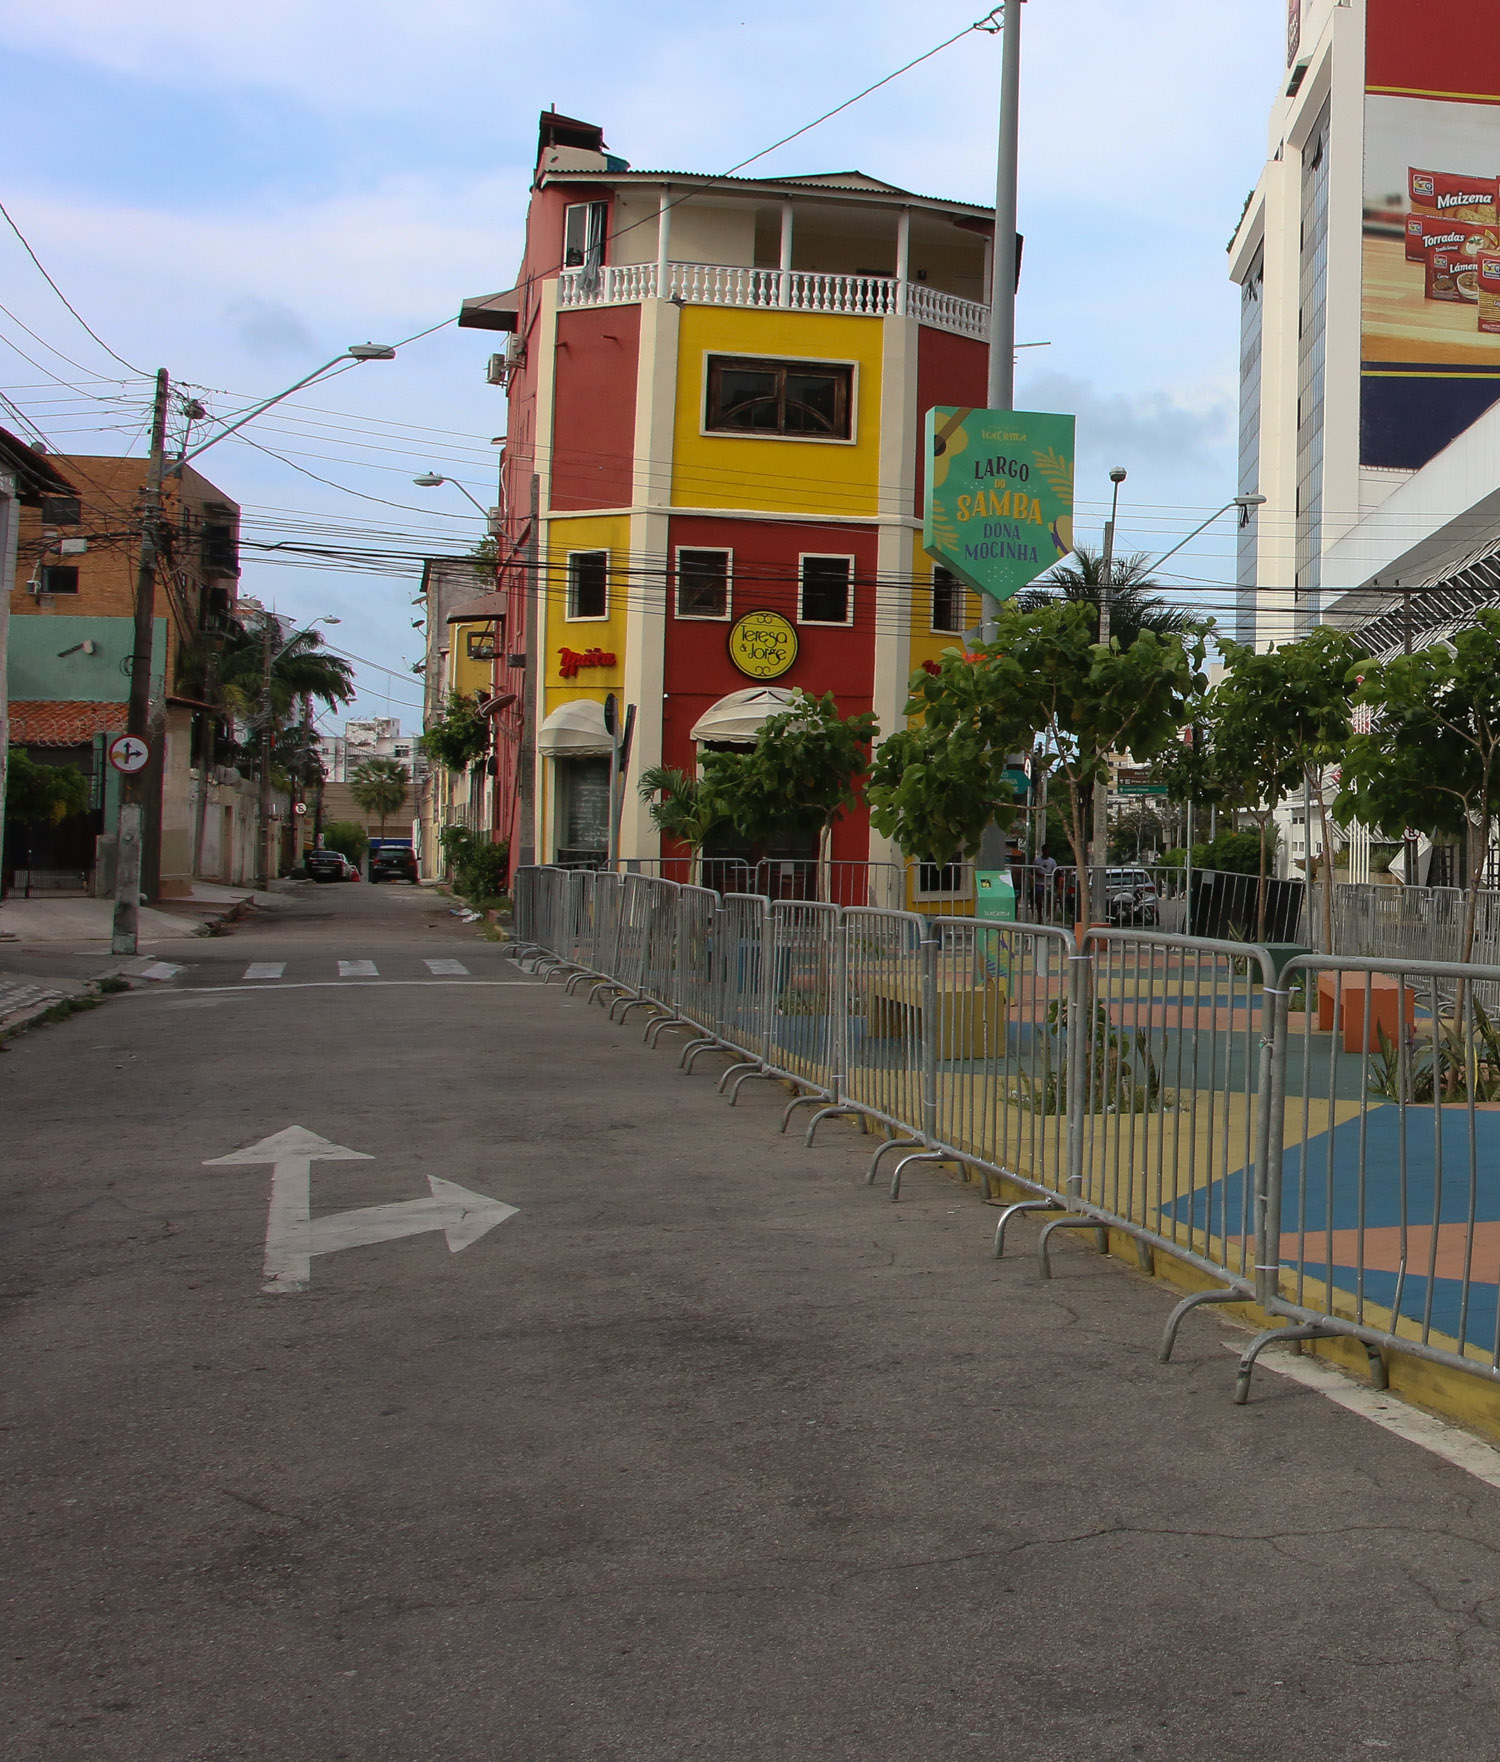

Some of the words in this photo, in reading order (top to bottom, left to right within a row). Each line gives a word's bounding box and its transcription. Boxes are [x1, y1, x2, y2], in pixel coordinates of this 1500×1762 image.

[1437, 192, 1492, 209] Maizena
[1422, 232, 1465, 247] Torradas
[974, 456, 1030, 482] LARGO
[994, 478, 1006, 489] DO
[956, 489, 1043, 526] SAMBA
[983, 522, 1021, 540] DONA
[964, 542, 1039, 563] MOCINHA
[741, 625, 788, 648] Teresa
[740, 644, 747, 652] &
[748, 643, 787, 666] Jorge
